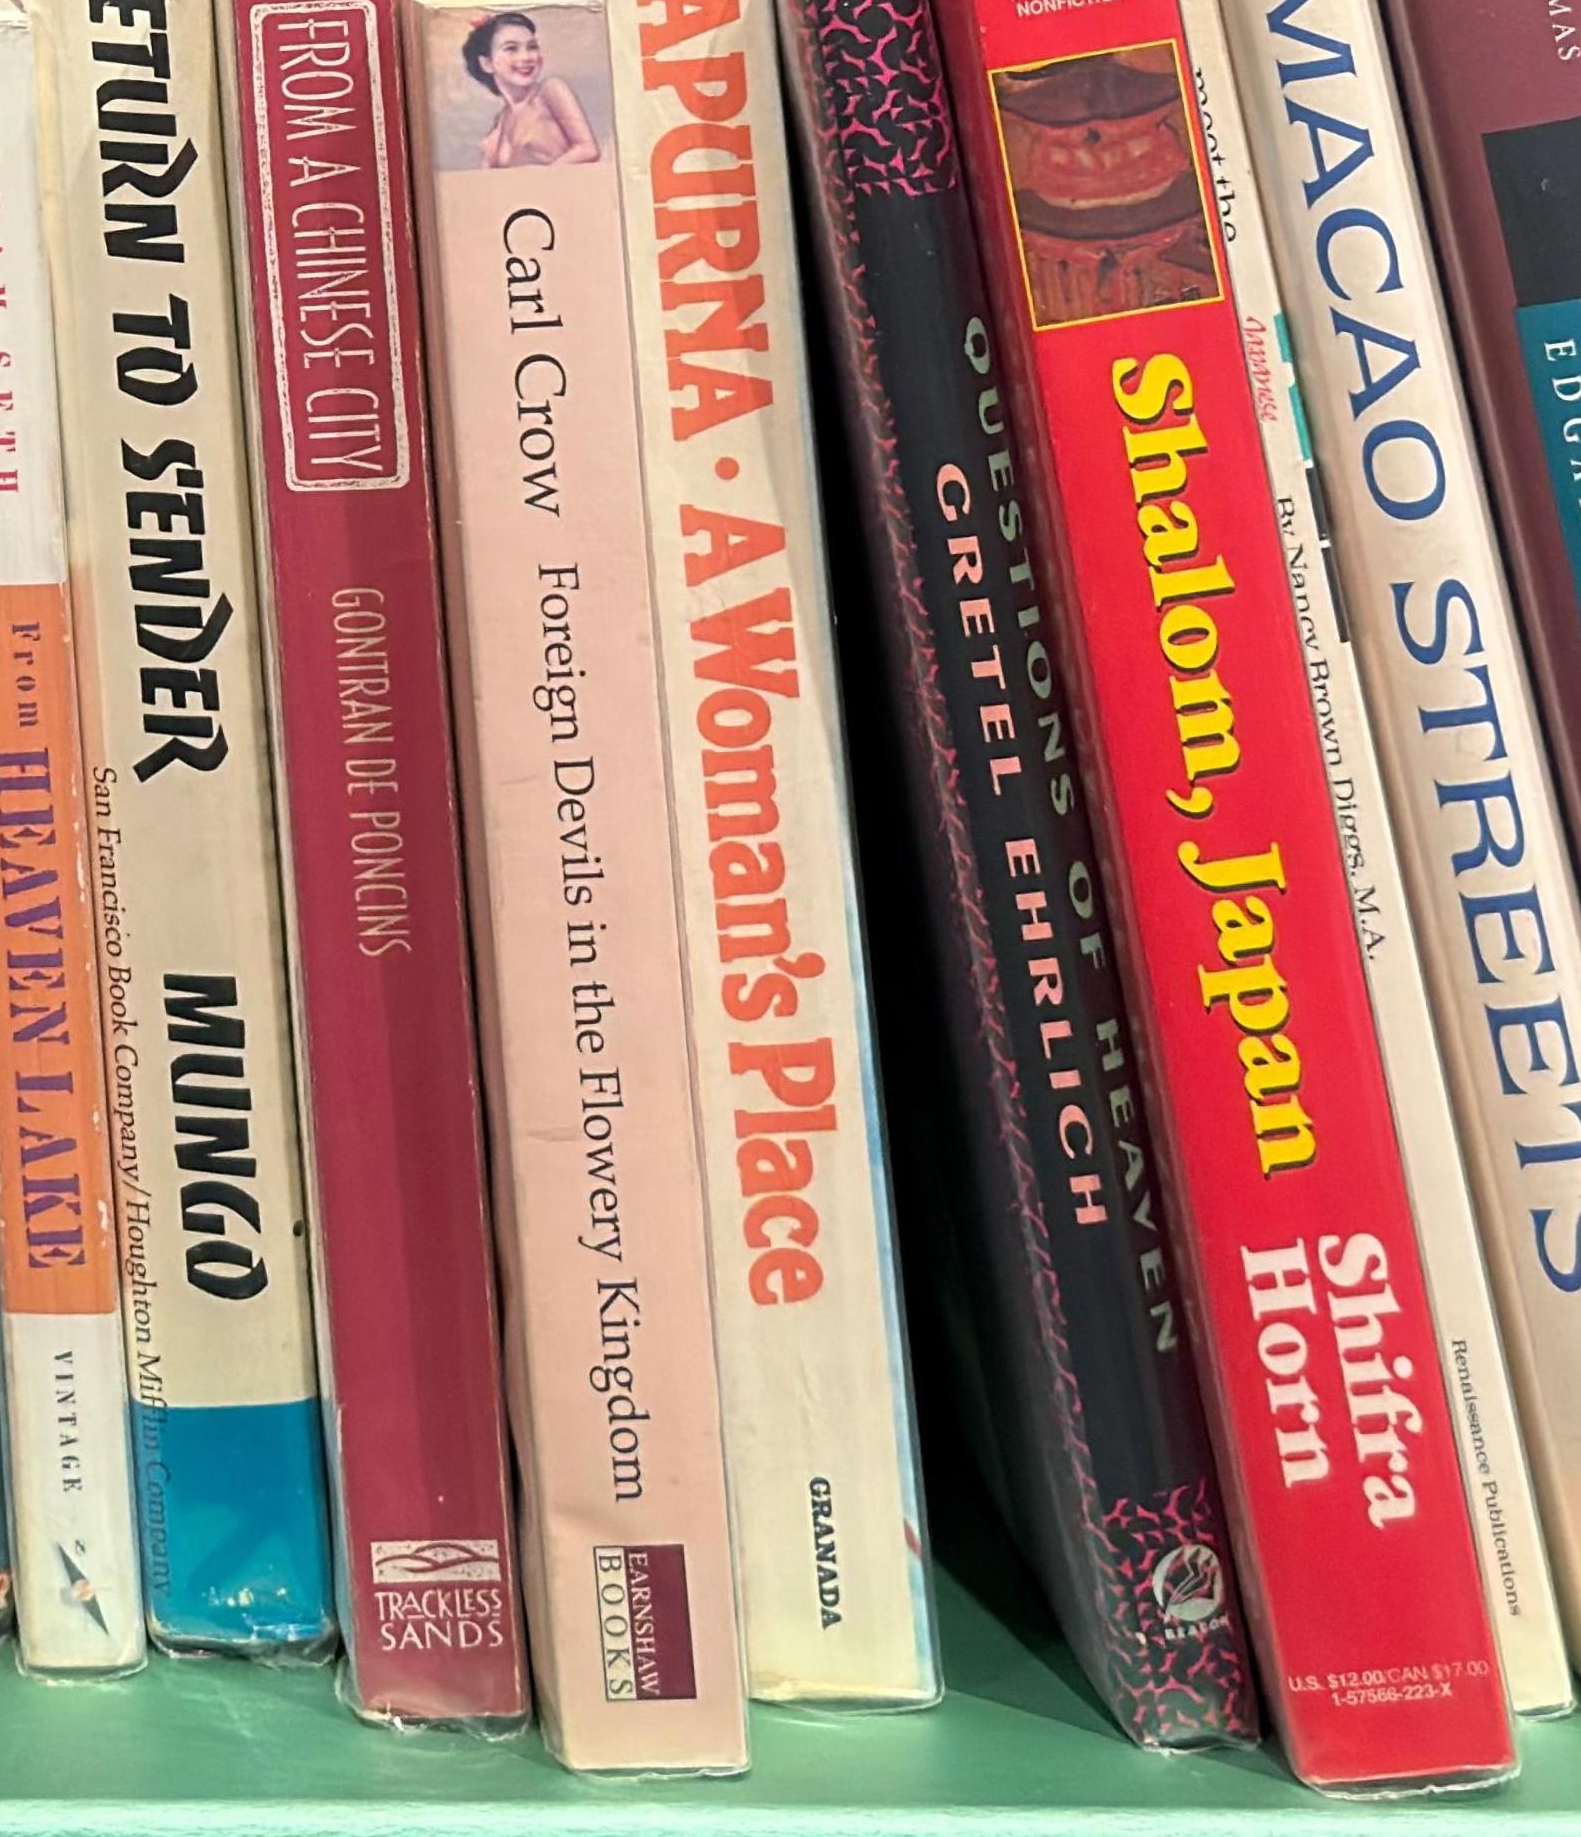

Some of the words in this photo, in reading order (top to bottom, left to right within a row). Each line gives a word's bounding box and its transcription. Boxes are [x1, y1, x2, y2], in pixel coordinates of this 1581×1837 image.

[278, 19, 358, 140] FROM
[289, 156, 362, 187] A
[291, 202, 375, 369] CHINESE
[502, 207, 563, 335] Carl
[111, 293, 198, 406] TO
[306, 388, 383, 472] CITY
[513, 354, 568, 518] Crow
[122, 438, 234, 782] SENDER
[680, 504, 786, 587] A
[11, 622, 41, 727] From
[331, 587, 395, 744] GONTRAN
[533, 562, 587, 744] Foreign
[1309, 658, 1342, 765] Brown
[92, 767, 116, 817] San
[346, 759, 398, 794] DE
[553, 756, 605, 905] Devils
[935, 462, 1023, 796] GRETEL
[1005, 837, 1108, 1224] EHRLICH
[963, 315, 1076, 817] QUESTIONS
[1068, 860, 1108, 971] OF
[1095, 1017, 1177, 1354] HEAVEN
[98, 828, 131, 958] Francisco
[349, 811, 412, 957] PONCINS
[567, 923, 607, 968] in
[108, 968, 138, 1035] Book
[571, 980, 615, 1054] the
[16, 1071, 87, 1269] LAKE
[578, 1067, 625, 1263] Flowery
[727, 1037, 839, 1307] Place
[53, 1349, 83, 1493] VINTAGE
[589, 1277, 651, 1502] Kingdom
[1317, 1232, 1422, 1530] Shifra
[1452, 1340, 1490, 1474] Renaissance
[1482, 1481, 1521, 1616] Publications
[374, 1587, 502, 1621] TRACKLESS
[599, 1554, 633, 1695] BOOKS
